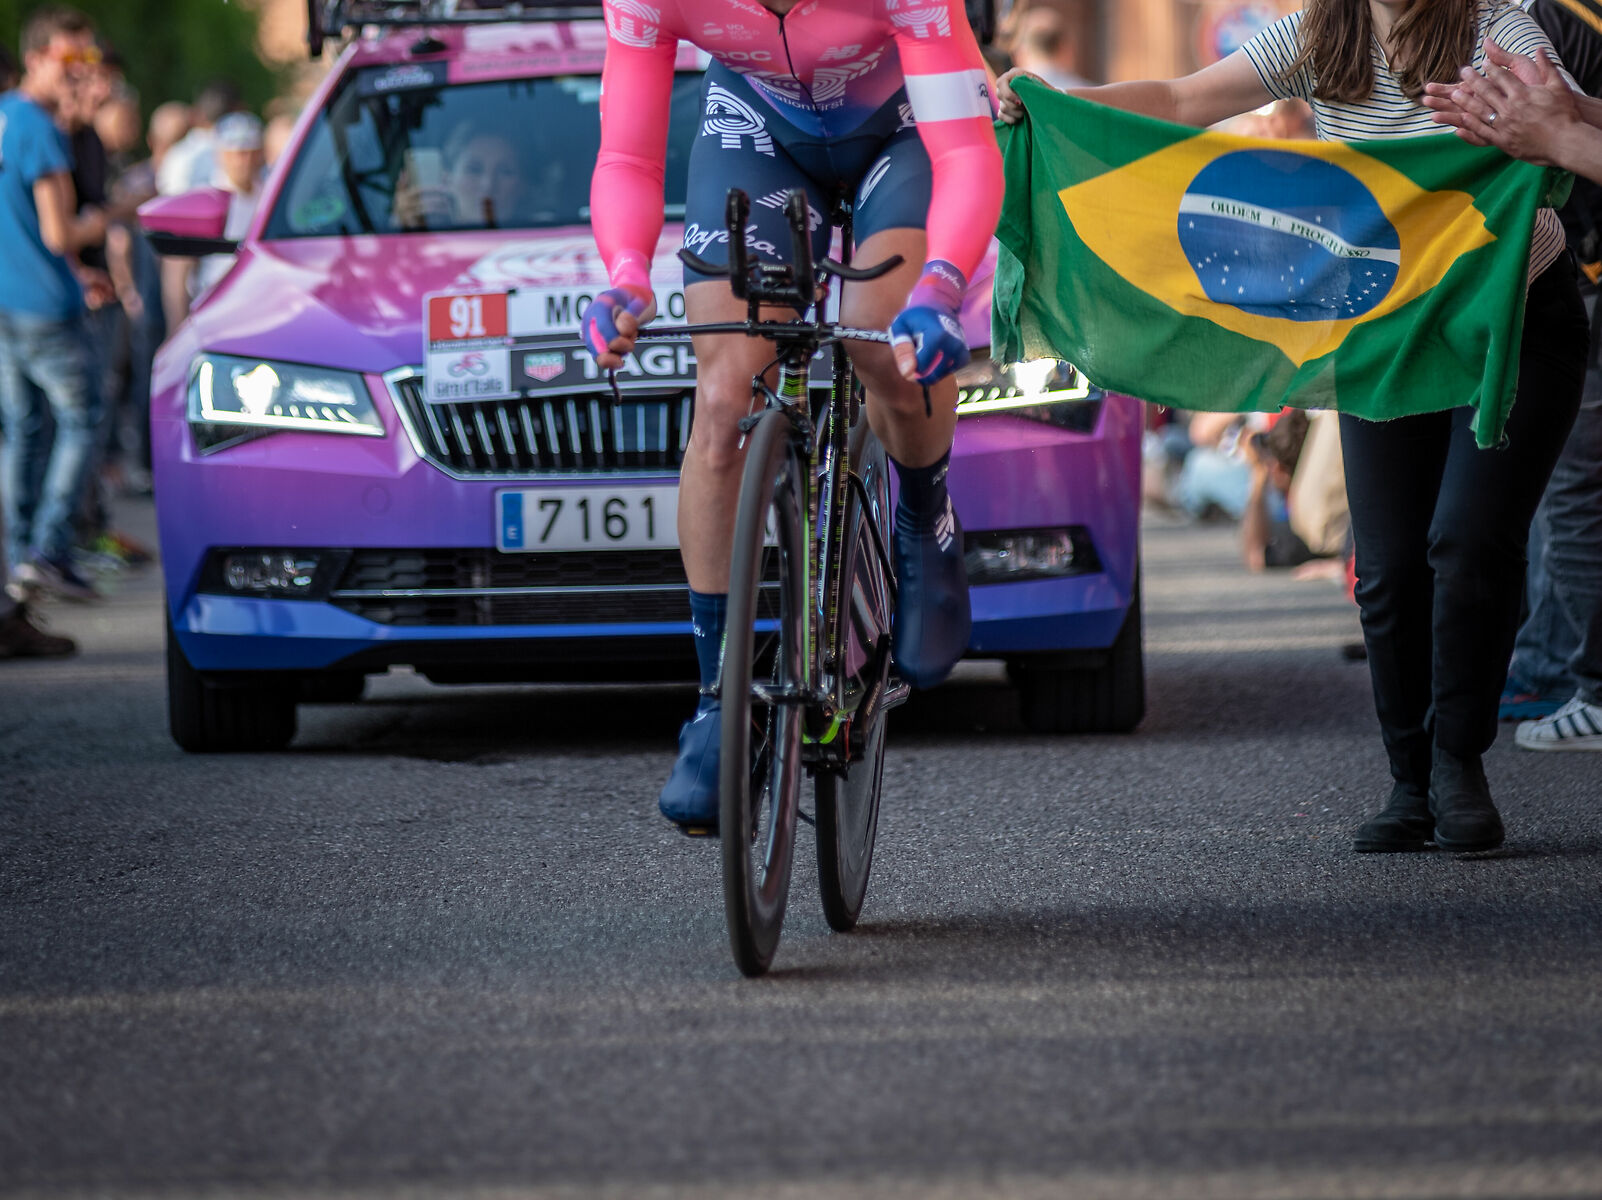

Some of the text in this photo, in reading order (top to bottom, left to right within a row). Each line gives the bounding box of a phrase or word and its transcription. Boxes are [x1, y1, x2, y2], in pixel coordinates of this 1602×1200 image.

[1210, 199, 1371, 258] ORDEM E PROGRESSO
[449, 295, 487, 339] 91
[537, 495, 656, 543] 7161
